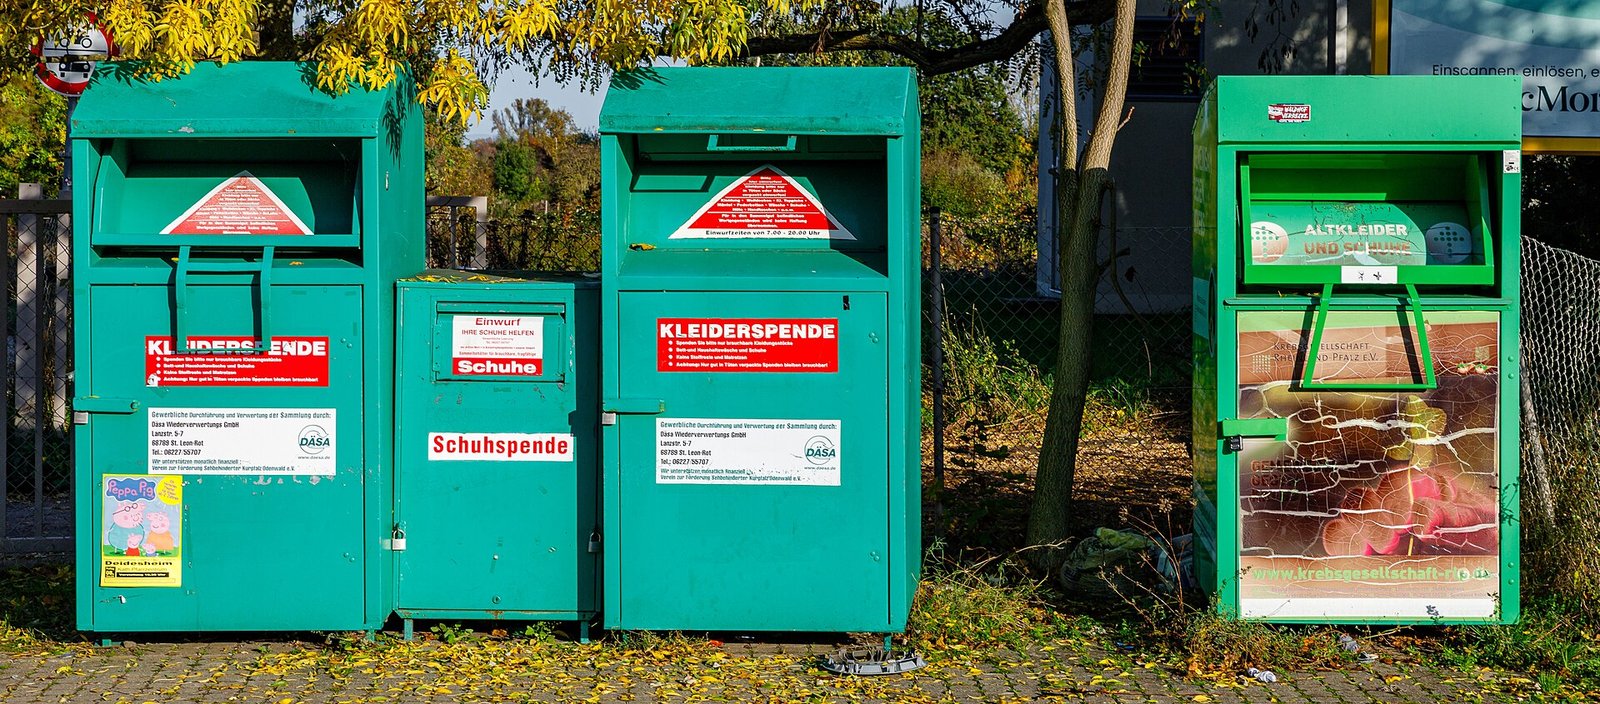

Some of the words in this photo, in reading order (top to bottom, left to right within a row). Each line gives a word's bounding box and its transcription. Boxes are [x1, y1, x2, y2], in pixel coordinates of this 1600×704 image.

[1523, 65, 1587, 80] einlösen,
[1305, 224, 1408, 236] ALTKLEIDER
[1304, 242, 1339, 255] UND
[1344, 242, 1412, 256] SCHUHE
[476, 318, 521, 326] Einwurf
[660, 324, 835, 339] KLEIDERSPENDE
[148, 340, 326, 356] KLIDERSENDE
[1274, 353, 1359, 361] RHEIND-PFALZ
[458, 360, 537, 374] Schuhe
[300, 435, 330, 447] DÄSA
[433, 435, 568, 457] Schuhspende
[806, 446, 836, 457] DÄSA
[109, 480, 138, 499] Peppa
[139, 480, 155, 499] Pig
